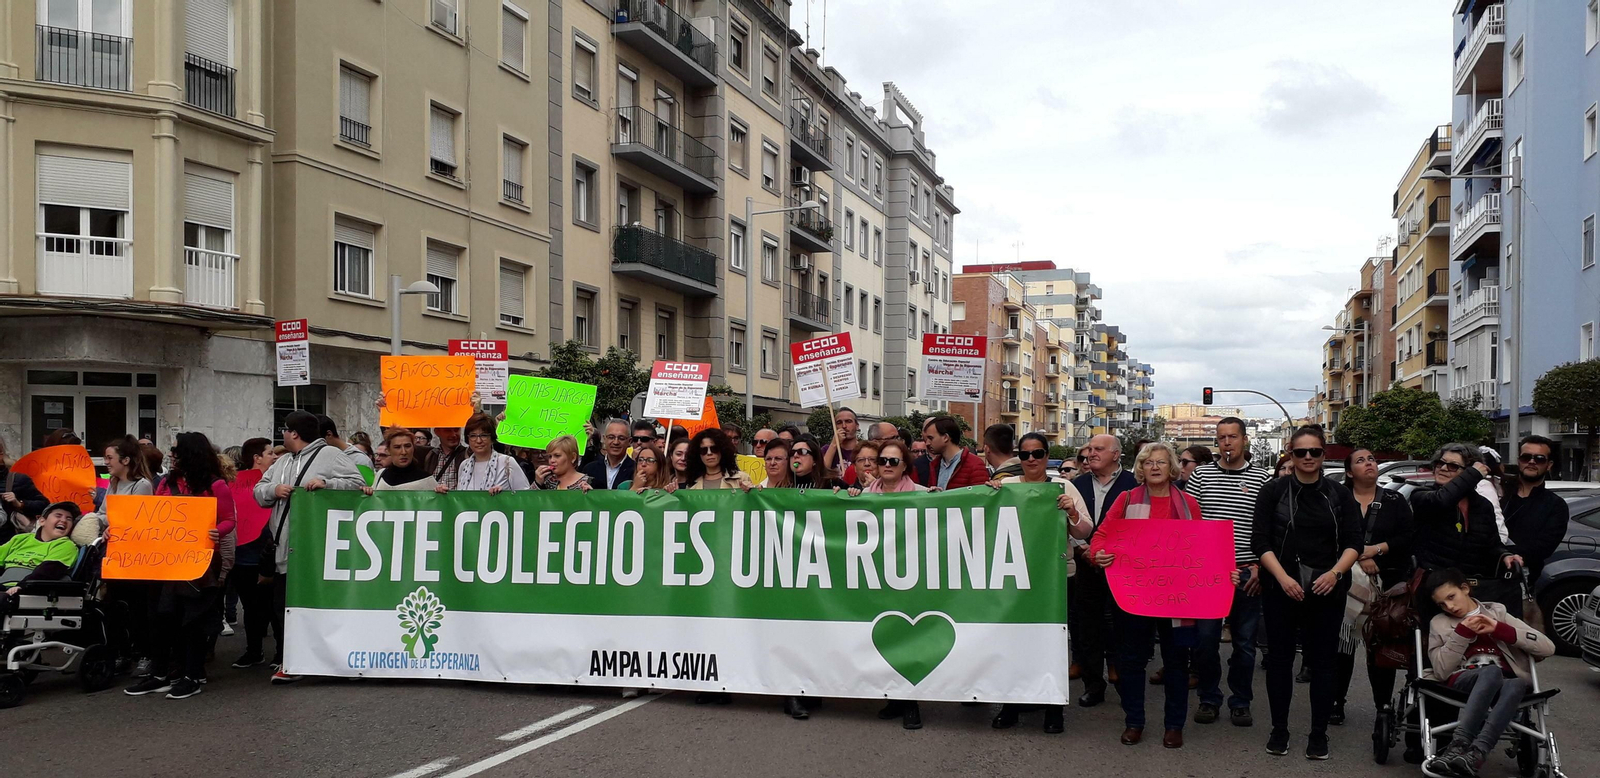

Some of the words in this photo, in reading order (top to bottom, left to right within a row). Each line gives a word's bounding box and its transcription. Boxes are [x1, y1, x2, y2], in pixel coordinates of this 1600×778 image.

[281, 321, 301, 332] CCOO
[278, 332, 305, 341] enseñanza
[803, 336, 839, 352] CCOO
[936, 336, 974, 346] CCOO
[460, 341, 496, 350] CCOO
[798, 345, 847, 362] enseñanza
[928, 345, 980, 355] enseñanza
[454, 350, 502, 359] enseñanza
[384, 360, 398, 380] 3
[400, 361, 440, 380] AÑOS
[445, 363, 475, 379] SIN
[657, 372, 703, 380] enseñanza
[665, 363, 699, 372] CCOO
[507, 380, 527, 397] NO
[552, 386, 594, 405] LARGAS
[520, 406, 530, 418] Y
[540, 407, 569, 424] MÁS
[41, 476, 61, 493] NO
[135, 500, 188, 523] NOS
[108, 526, 199, 543] SENTIMOS
[1113, 527, 1143, 549] EN
[1150, 528, 1197, 551] LOS
[323, 509, 443, 582] ESTE
[453, 510, 645, 586] COLEGIO
[662, 509, 716, 586] ES
[730, 509, 832, 589] UNA
[845, 506, 1031, 590] RUINA
[1113, 553, 1206, 570] ASILLOS
[1109, 573, 1178, 588] TIENEN
[1187, 573, 1223, 589] QUE
[1127, 593, 1190, 606] JUGAR
[348, 651, 366, 669] CEE
[369, 651, 408, 669] VIRGEN
[411, 660, 418, 669] DE
[420, 660, 427, 669] LA
[430, 652, 480, 671] ESPERANZA
[589, 650, 642, 678] AMPA
[647, 651, 668, 679] LA
[672, 652, 719, 681] SAVIA
